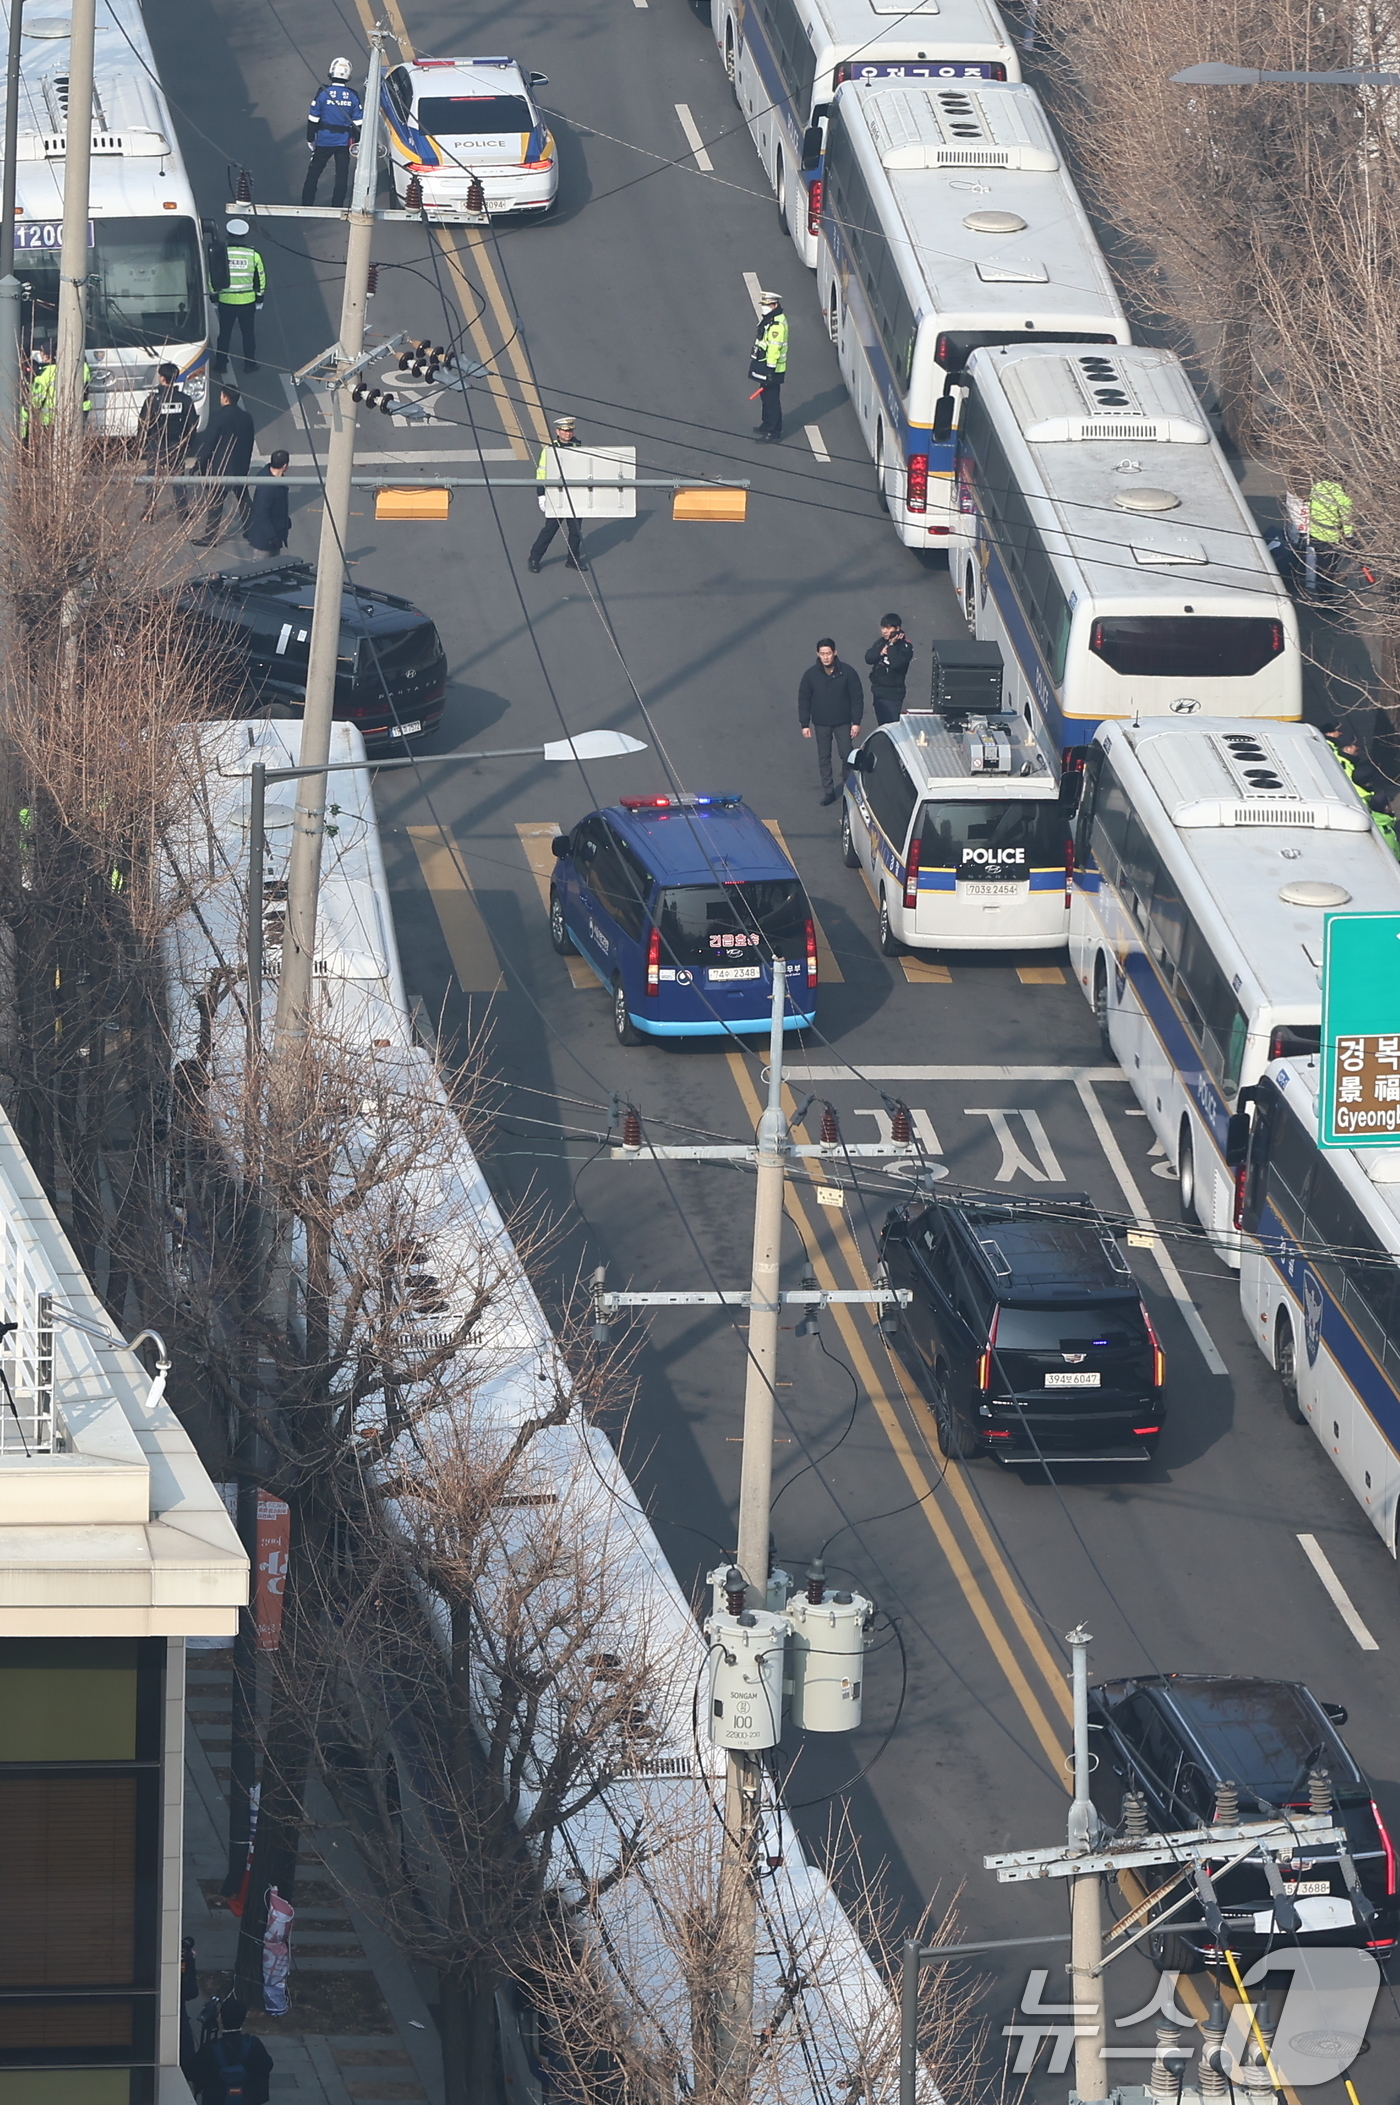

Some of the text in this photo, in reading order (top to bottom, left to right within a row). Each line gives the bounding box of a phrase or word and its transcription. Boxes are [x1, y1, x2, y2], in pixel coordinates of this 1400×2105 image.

[326, 99, 353, 107] POLICE
[454, 139, 506, 149] POLICE
[962, 848, 1026, 864] POLICE
[709, 933, 760, 948] 긴급호송
[733, 969, 757, 978] 2348
[1197, 1073, 1217, 1127] POLICE
[1337, 1104, 1400, 1132] Gyeong
[730, 1691, 758, 1700] SONGAM
[733, 1715, 753, 1729] 100
[1302, 1883, 1327, 1893] 3688
